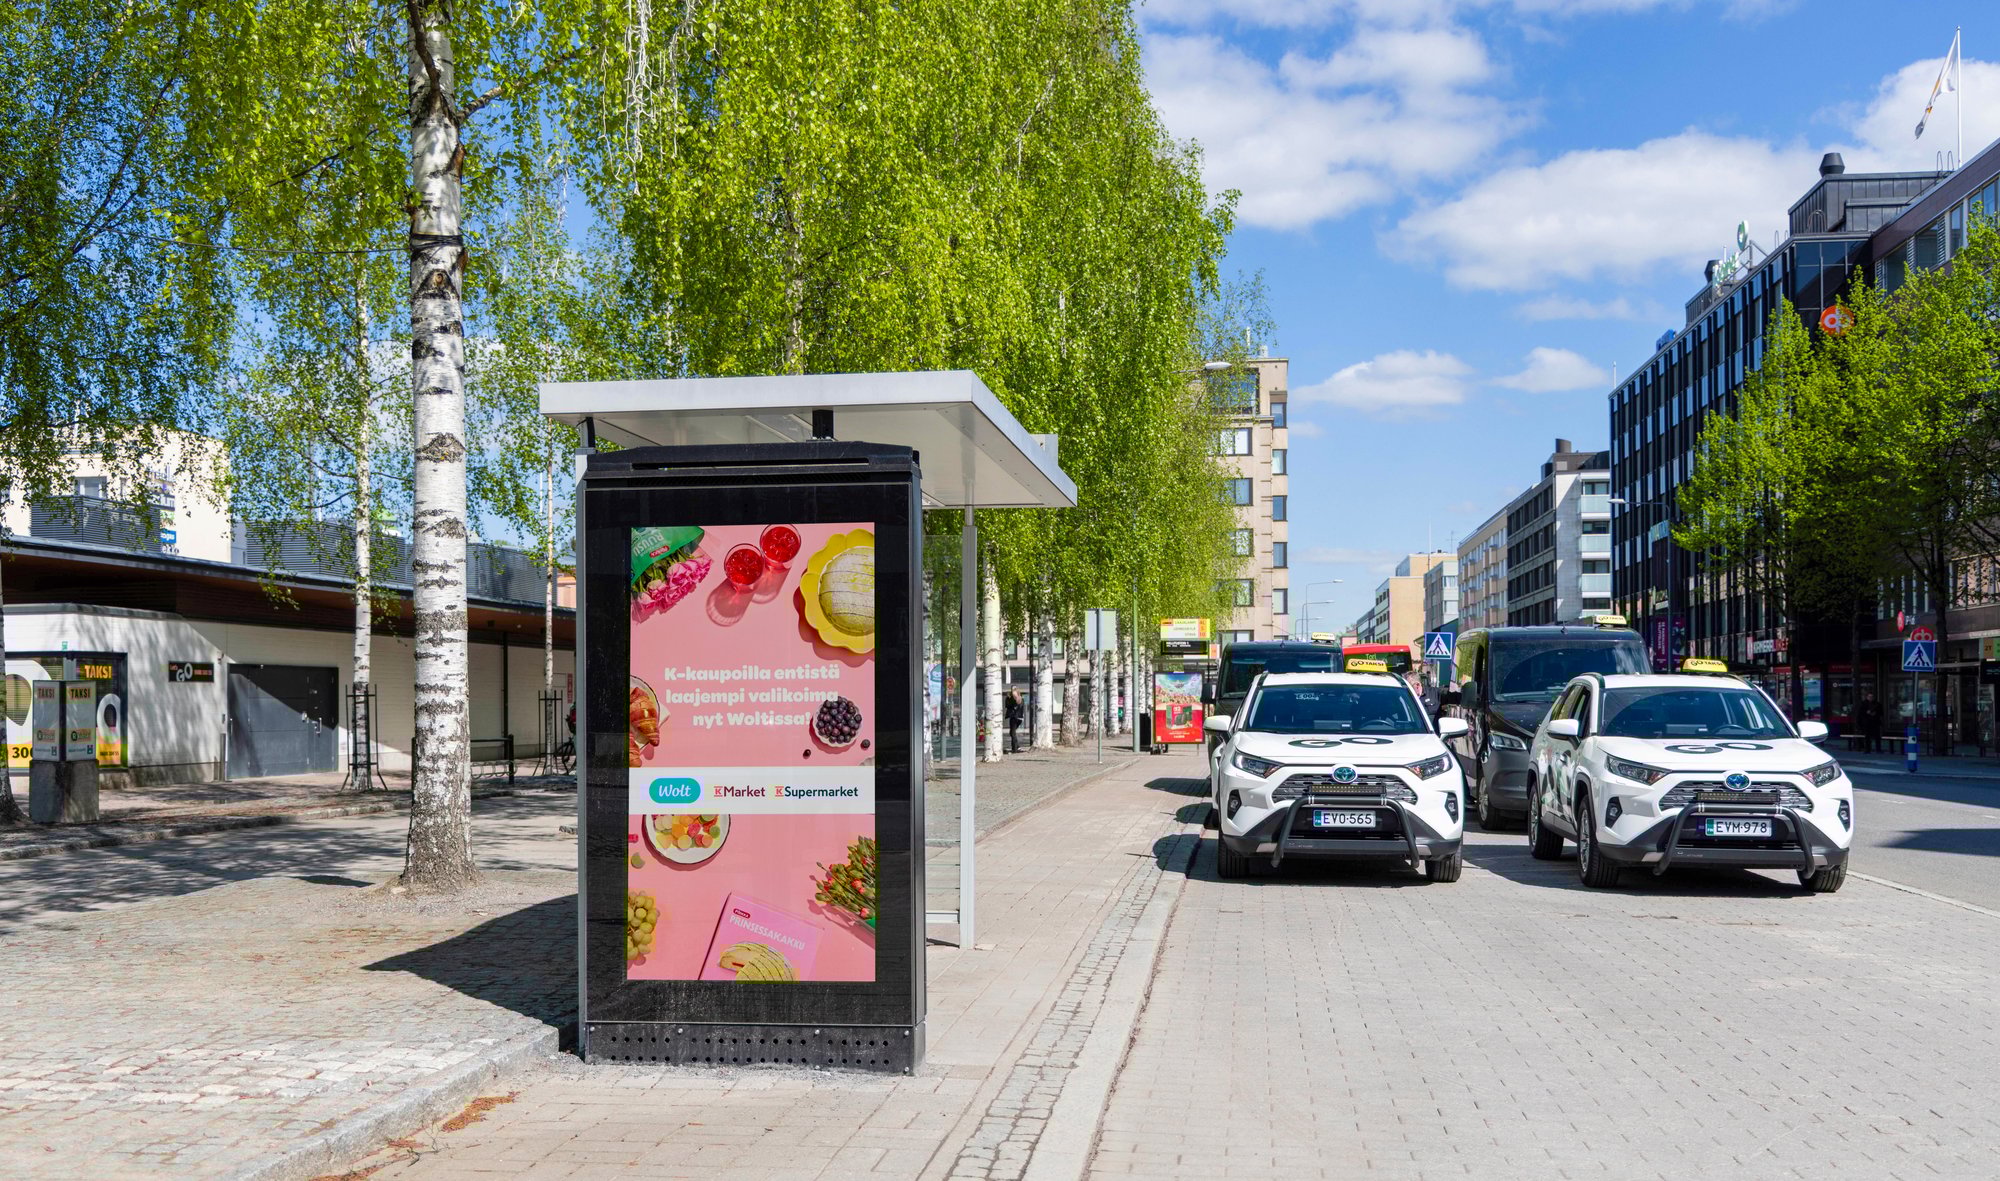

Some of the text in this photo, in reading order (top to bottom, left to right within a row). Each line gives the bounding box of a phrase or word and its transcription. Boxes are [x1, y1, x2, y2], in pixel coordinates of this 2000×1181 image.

[84, 664, 112, 679] TAKSI
[664, 664, 840, 684] K-kaupoilla entistä
[38, 688, 55, 698] TAKSI
[70, 688, 91, 698] TAKSI
[666, 688, 839, 706] laajempi valikoima
[692, 711, 811, 729] nyt Woltissa!
[658, 784, 692, 797] Wolt
[1323, 813, 1372, 825] EVO-565
[1716, 821, 1768, 833] EVM-978
[729, 915, 806, 951] PRINSESSAKAKKU
